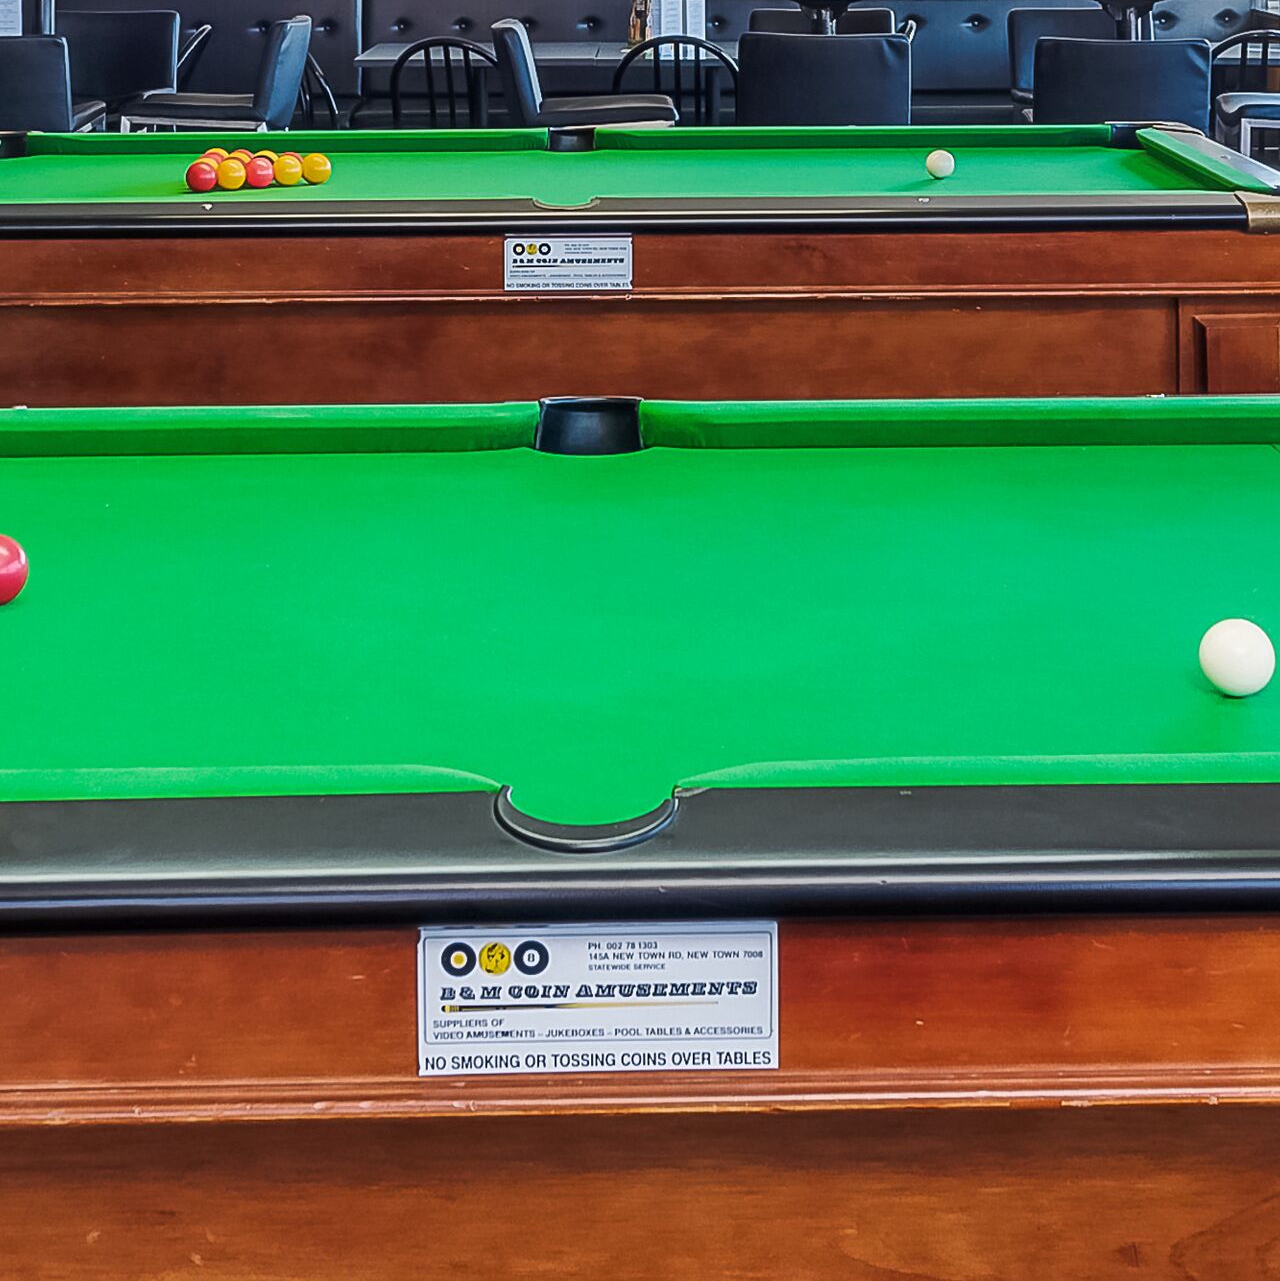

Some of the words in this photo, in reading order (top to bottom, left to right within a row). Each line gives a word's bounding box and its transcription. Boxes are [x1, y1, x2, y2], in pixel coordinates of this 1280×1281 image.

[638, 941, 658, 949] 1303
[528, 953, 535, 962] 8
[612, 952, 634, 960] NEW
[638, 952, 665, 960] TOWN
[743, 950, 764, 958] 7008
[634, 962, 666, 970] SERVICE
[440, 986, 456, 1000] B
[459, 986, 476, 1000] &
[480, 986, 502, 999] M
[508, 984, 570, 999] COIN
[575, 981, 758, 998] AMUSEMENTS
[433, 1020, 488, 1028] SUPPLIERS
[491, 1019, 505, 1027] OF
[433, 1031, 464, 1040] VIDEO
[466, 1029, 535, 1039] AMUSEMENTS
[545, 1028, 604, 1038] JUKEBOXES
[614, 1028, 642, 1036] POOL
[646, 1027, 682, 1036] TABLES
[684, 1027, 691, 1035] &
[693, 1026, 763, 1035] ACCESSORIES
[425, 1056, 447, 1070] NO
[451, 1055, 520, 1069] SMOKING
[524, 1054, 546, 1068] OR
[551, 1053, 616, 1068] TOSSING
[621, 1052, 667, 1066] COINS
[671, 1051, 712, 1066] OVER
[716, 1051, 772, 1065] TABLES
